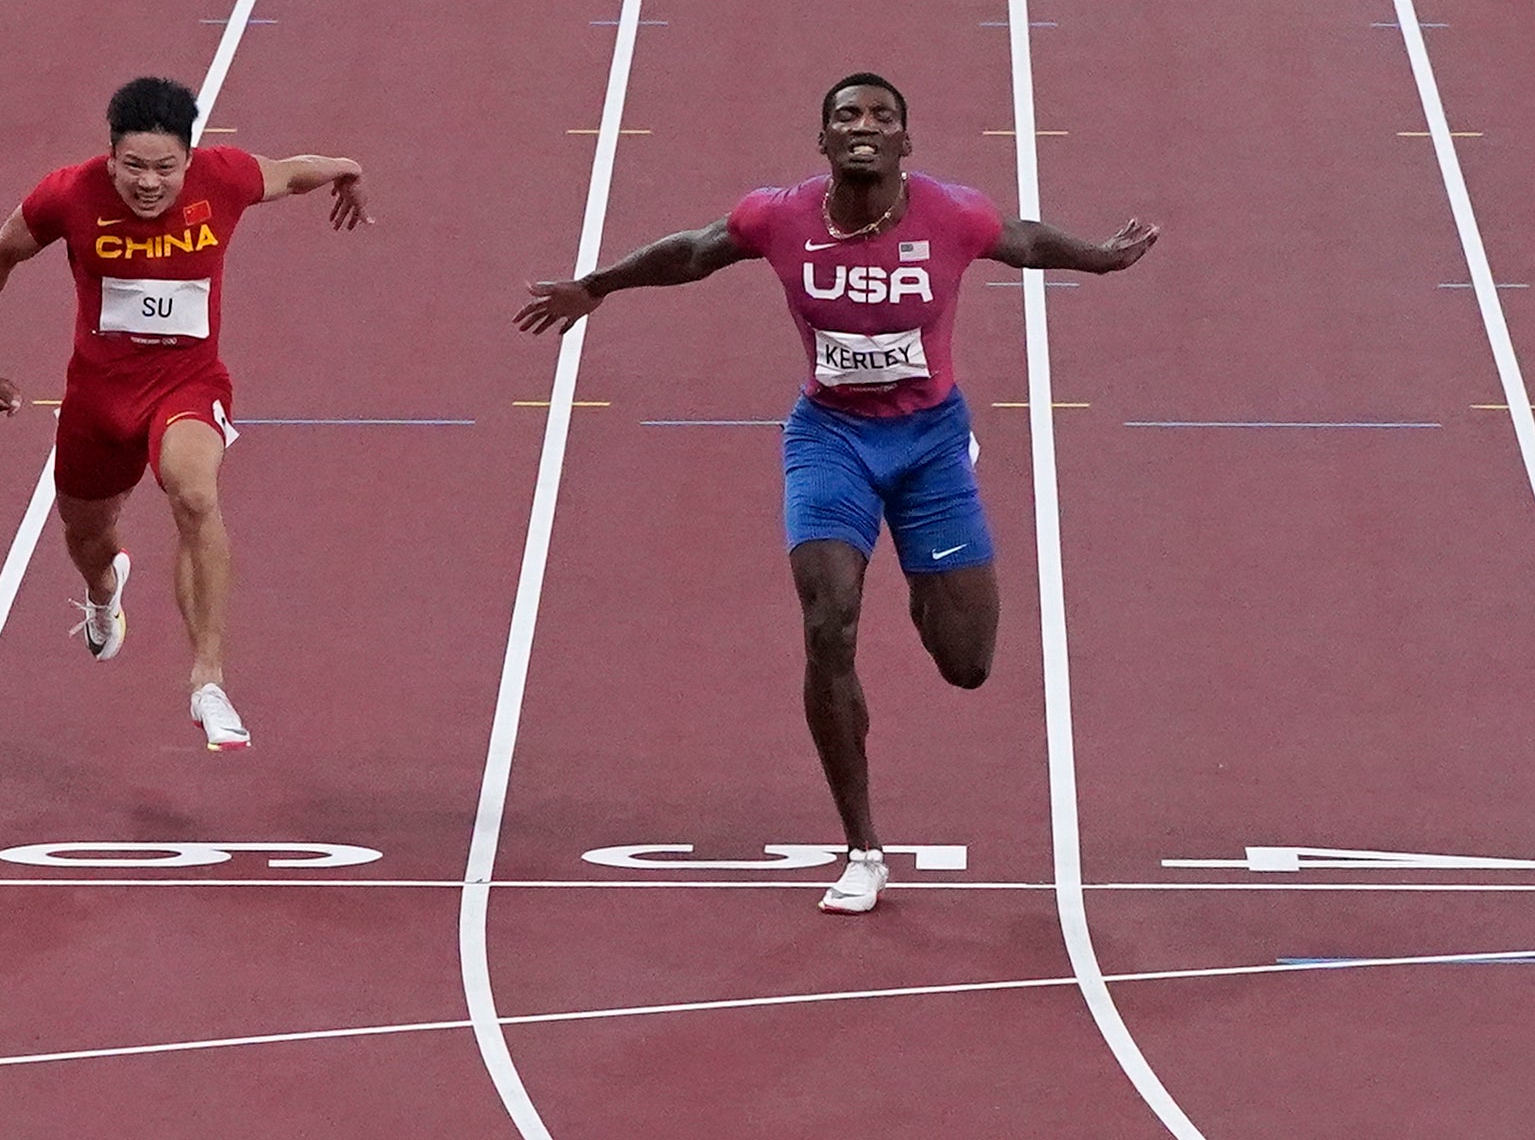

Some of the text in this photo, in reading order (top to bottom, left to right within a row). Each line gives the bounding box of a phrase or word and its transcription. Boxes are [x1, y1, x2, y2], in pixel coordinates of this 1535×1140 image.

[95, 223, 219, 259] CHINA
[802, 262, 934, 303] USA
[141, 297, 173, 318] SU
[825, 343, 912, 370] KERLEY
